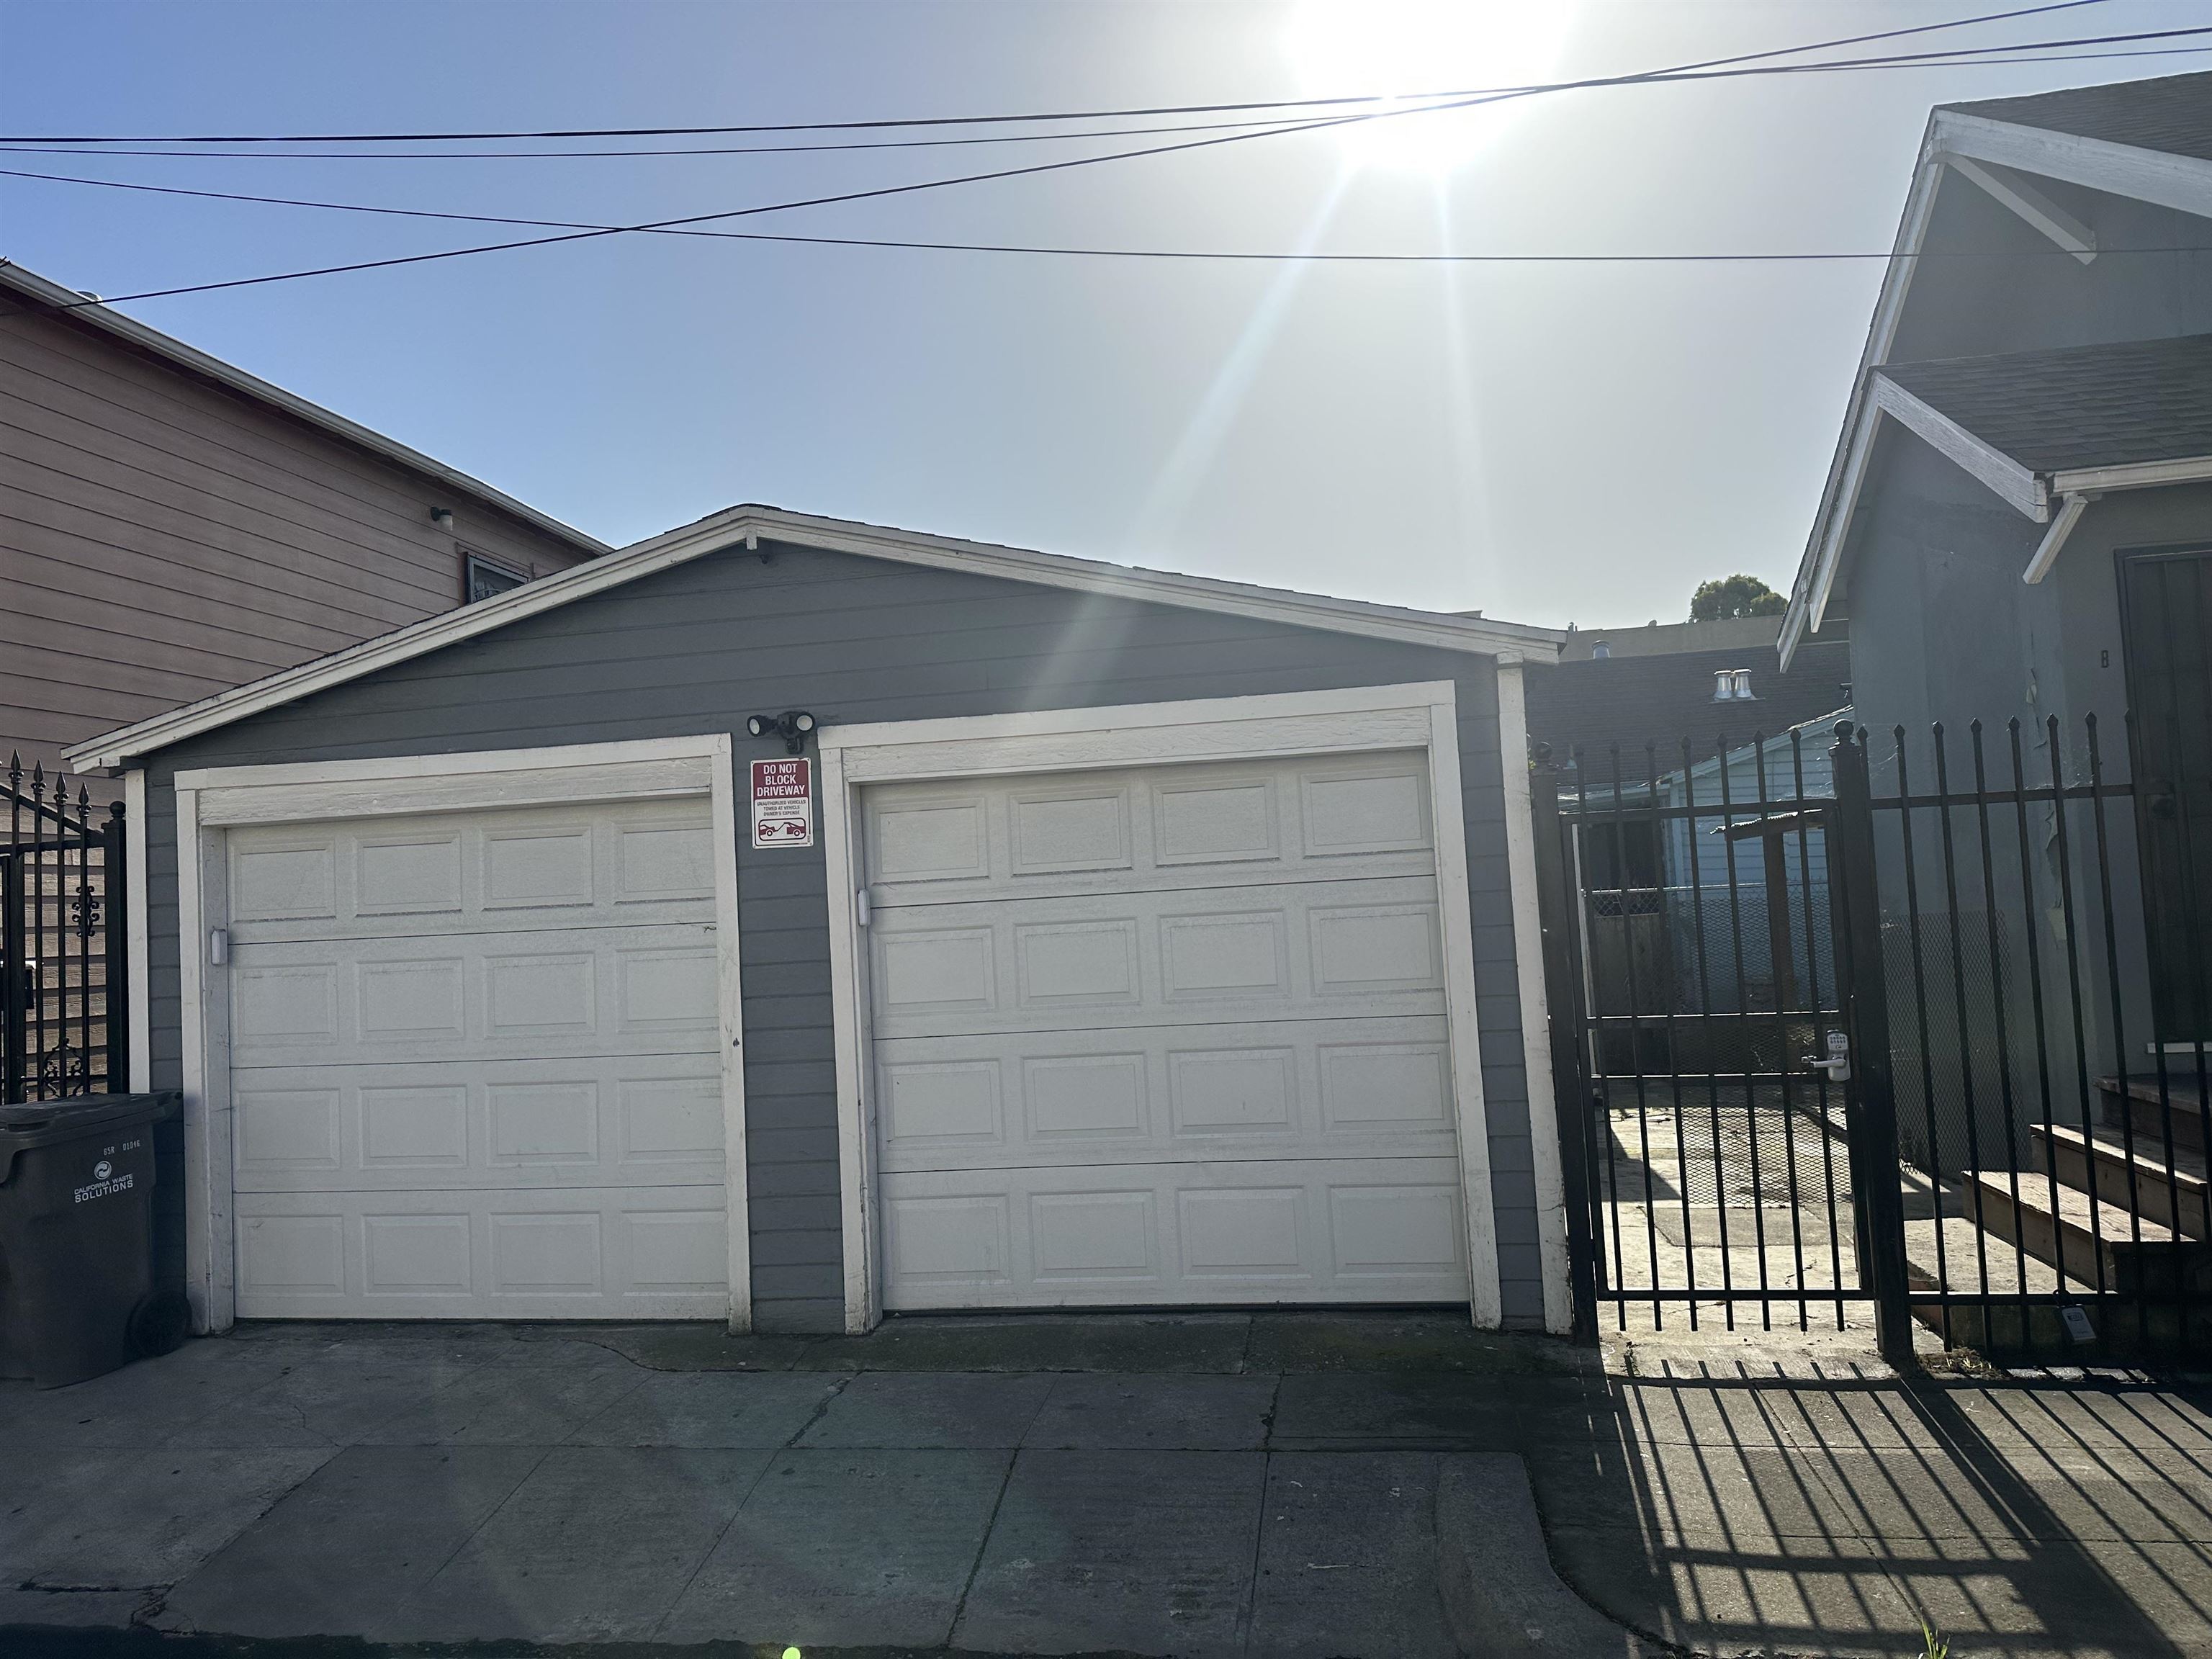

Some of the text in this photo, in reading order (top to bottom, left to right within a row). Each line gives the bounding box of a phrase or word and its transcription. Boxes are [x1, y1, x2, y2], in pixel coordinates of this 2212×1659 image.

[763, 763, 797, 774] DO NOT
[765, 775, 796, 785] BLOCK
[757, 785, 805, 796] DRIVEWAY
[74, 1173, 133, 1195] CALIFORNIA WASTE
[74, 1179, 134, 1203] SOLUTIONS
